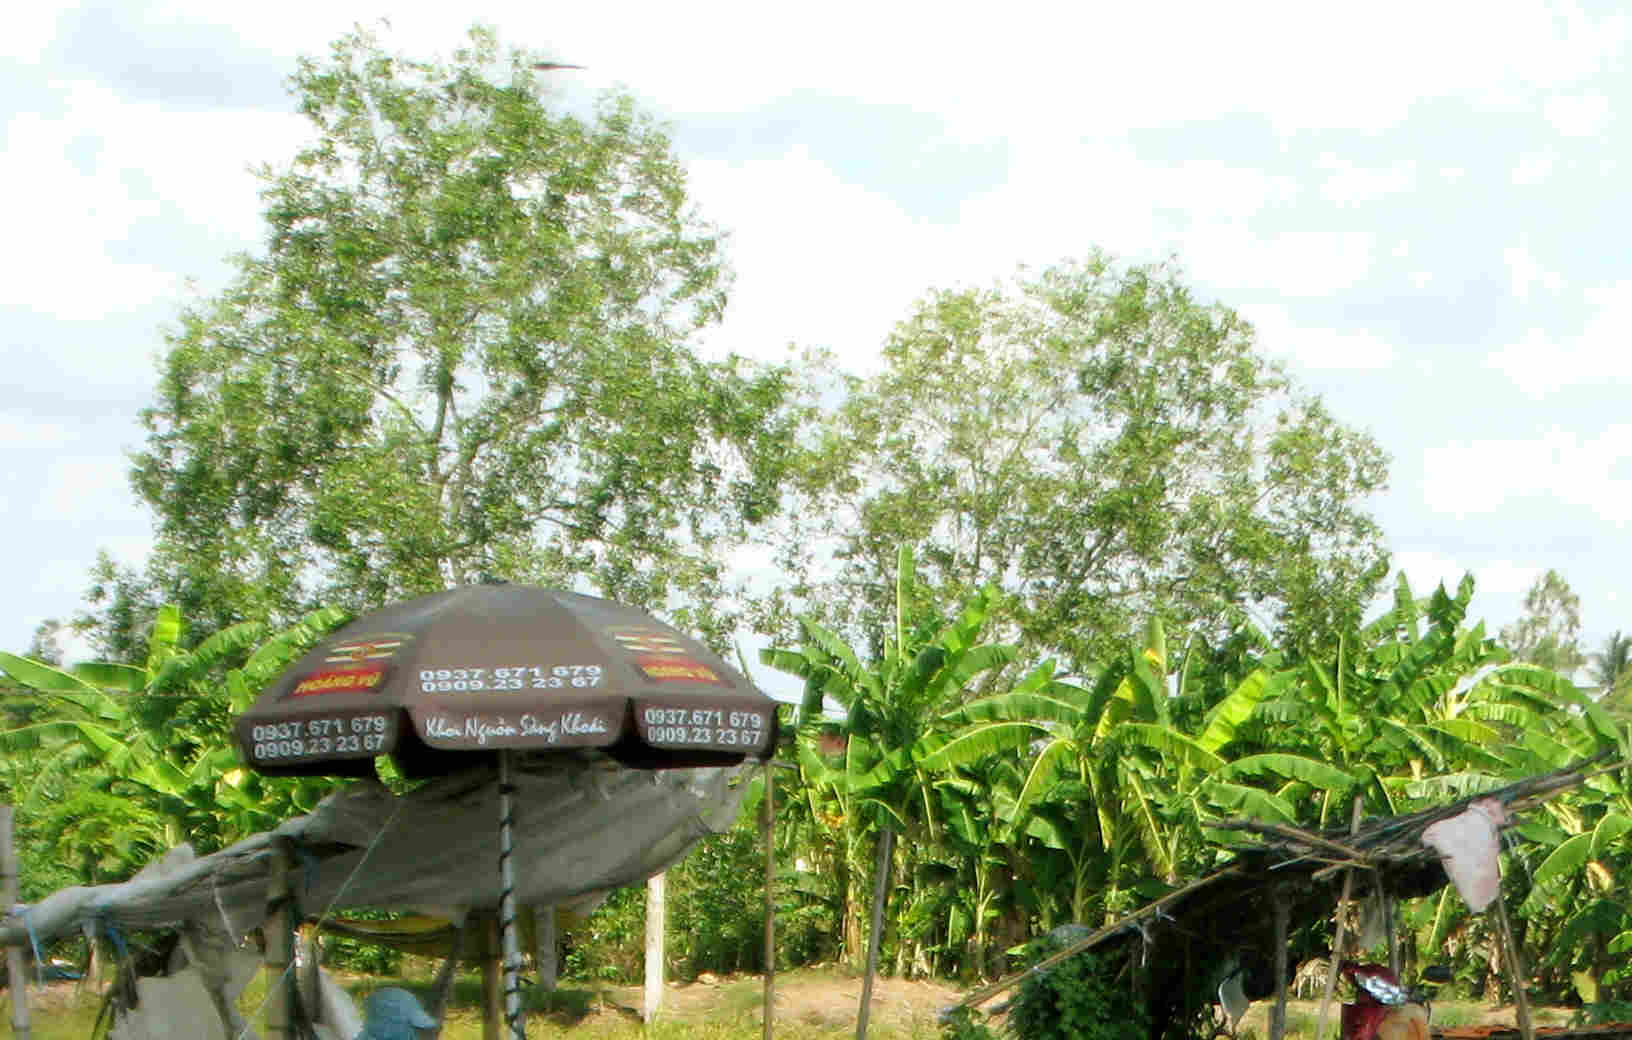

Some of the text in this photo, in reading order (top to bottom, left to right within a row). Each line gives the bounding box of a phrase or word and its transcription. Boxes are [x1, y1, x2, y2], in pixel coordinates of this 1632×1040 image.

[532, 677, 563, 688] 23
[571, 676, 601, 688] 67
[645, 709, 761, 728] 0937.671 679
[253, 716, 385, 742] 0937.671 679
[648, 726, 761, 745] 0909.23 23 67
[254, 734, 385, 759] 0909.23 23 67
